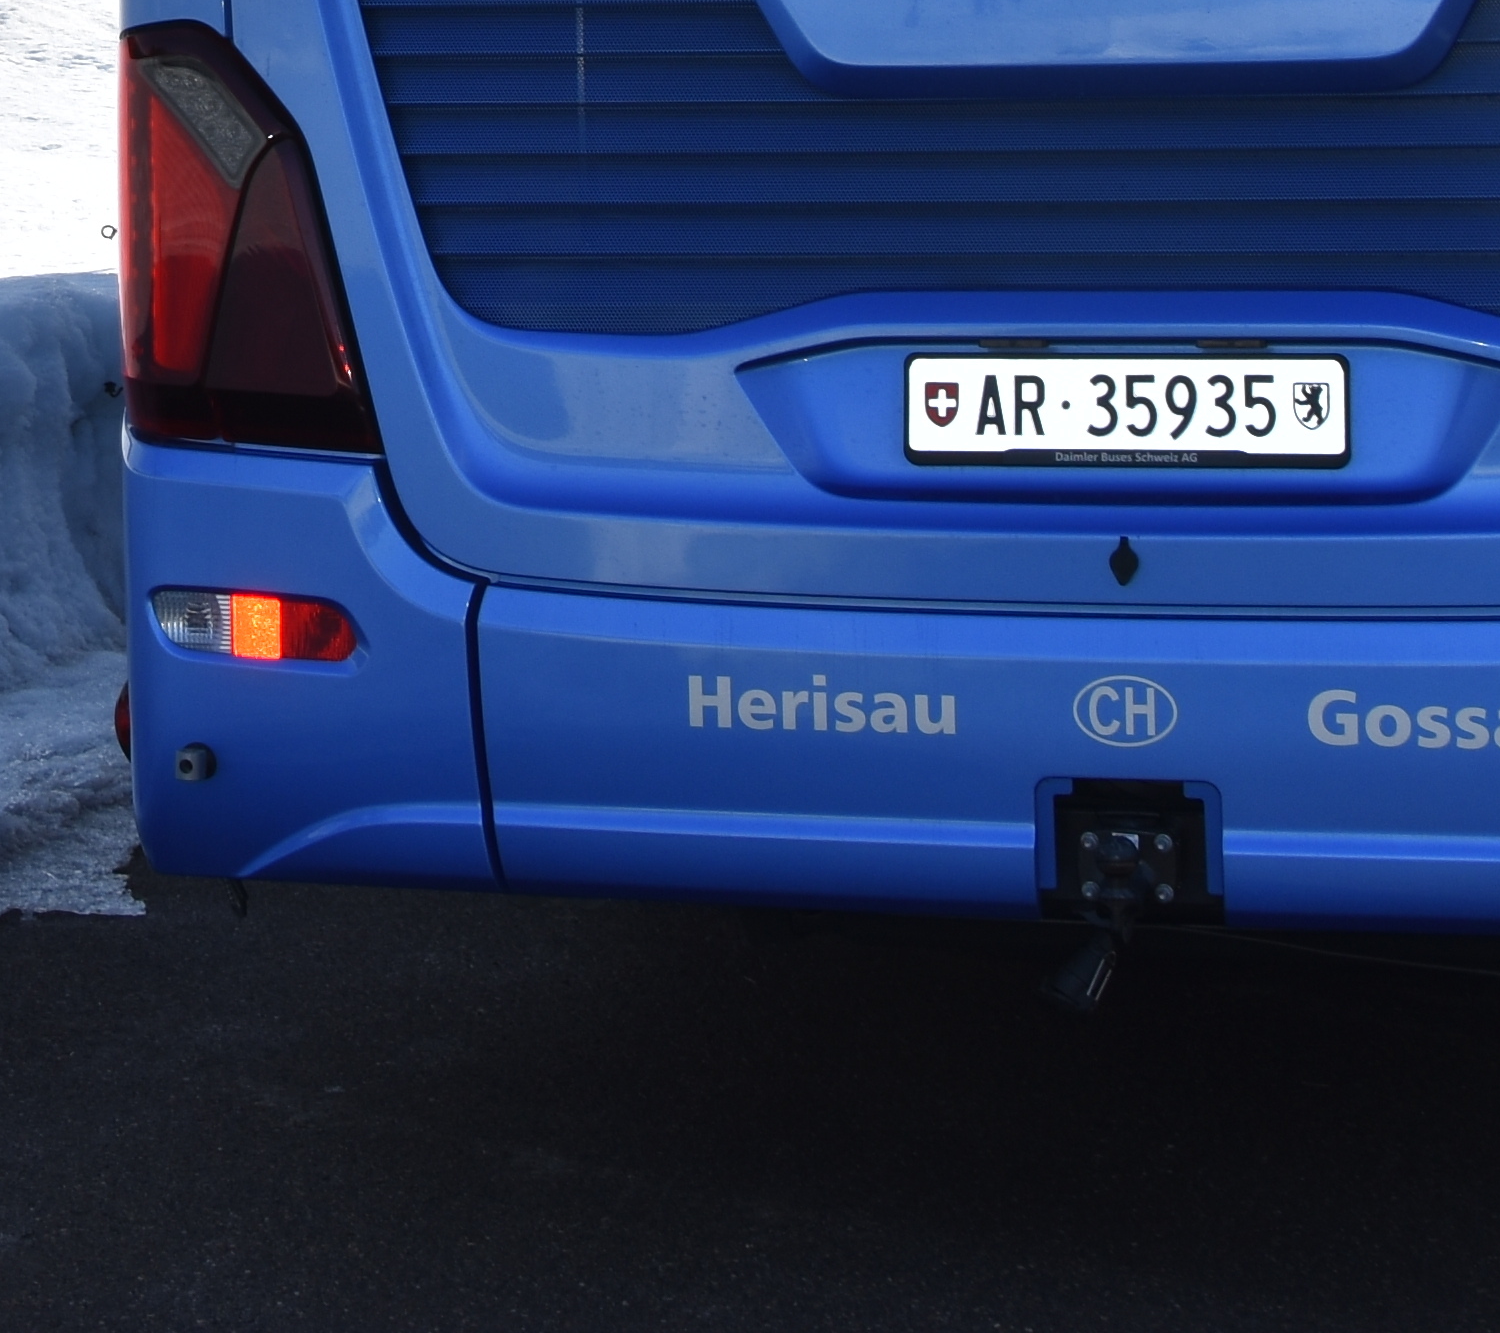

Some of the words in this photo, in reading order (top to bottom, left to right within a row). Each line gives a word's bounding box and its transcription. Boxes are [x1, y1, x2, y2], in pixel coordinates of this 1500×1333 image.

[1055, 451, 1099, 463] Daimler
[1101, 452, 1133, 463] Buses
[1134, 452, 1179, 463] Schweiz
[1181, 452, 1198, 463] AG
[688, 674, 957, 735] Herisau
[1088, 685, 1157, 736] CH
